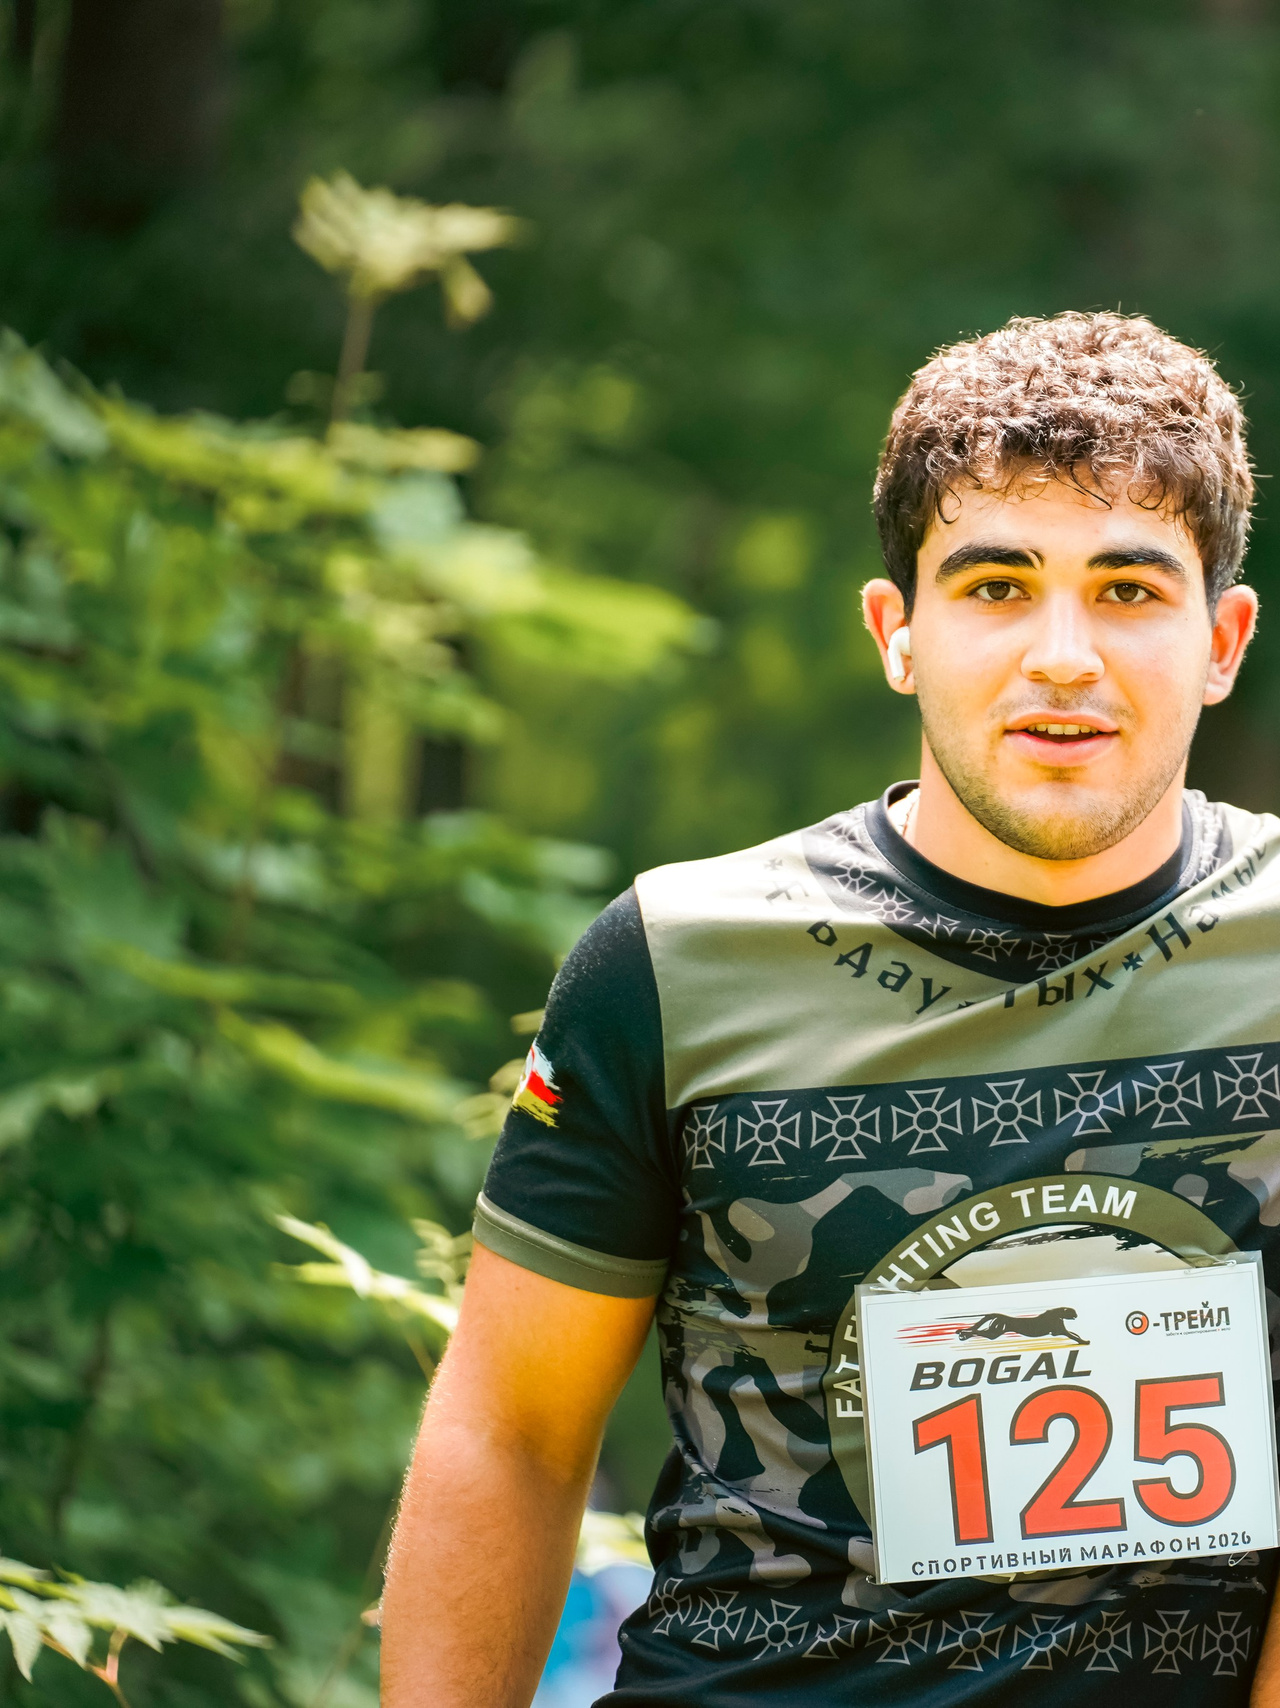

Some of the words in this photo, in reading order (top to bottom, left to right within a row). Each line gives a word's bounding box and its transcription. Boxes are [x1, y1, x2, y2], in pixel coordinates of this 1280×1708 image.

[1011, 1184, 1138, 1219] TEAM
[909, 1350, 1092, 1391] BOGAL
[912, 1372, 1237, 1546] 125
[911, 1546, 1072, 1576] СПОРТИВНЫЙ
[1080, 1536, 1201, 1561] МАРАФОН
[1208, 1531, 1252, 1549] 2026
